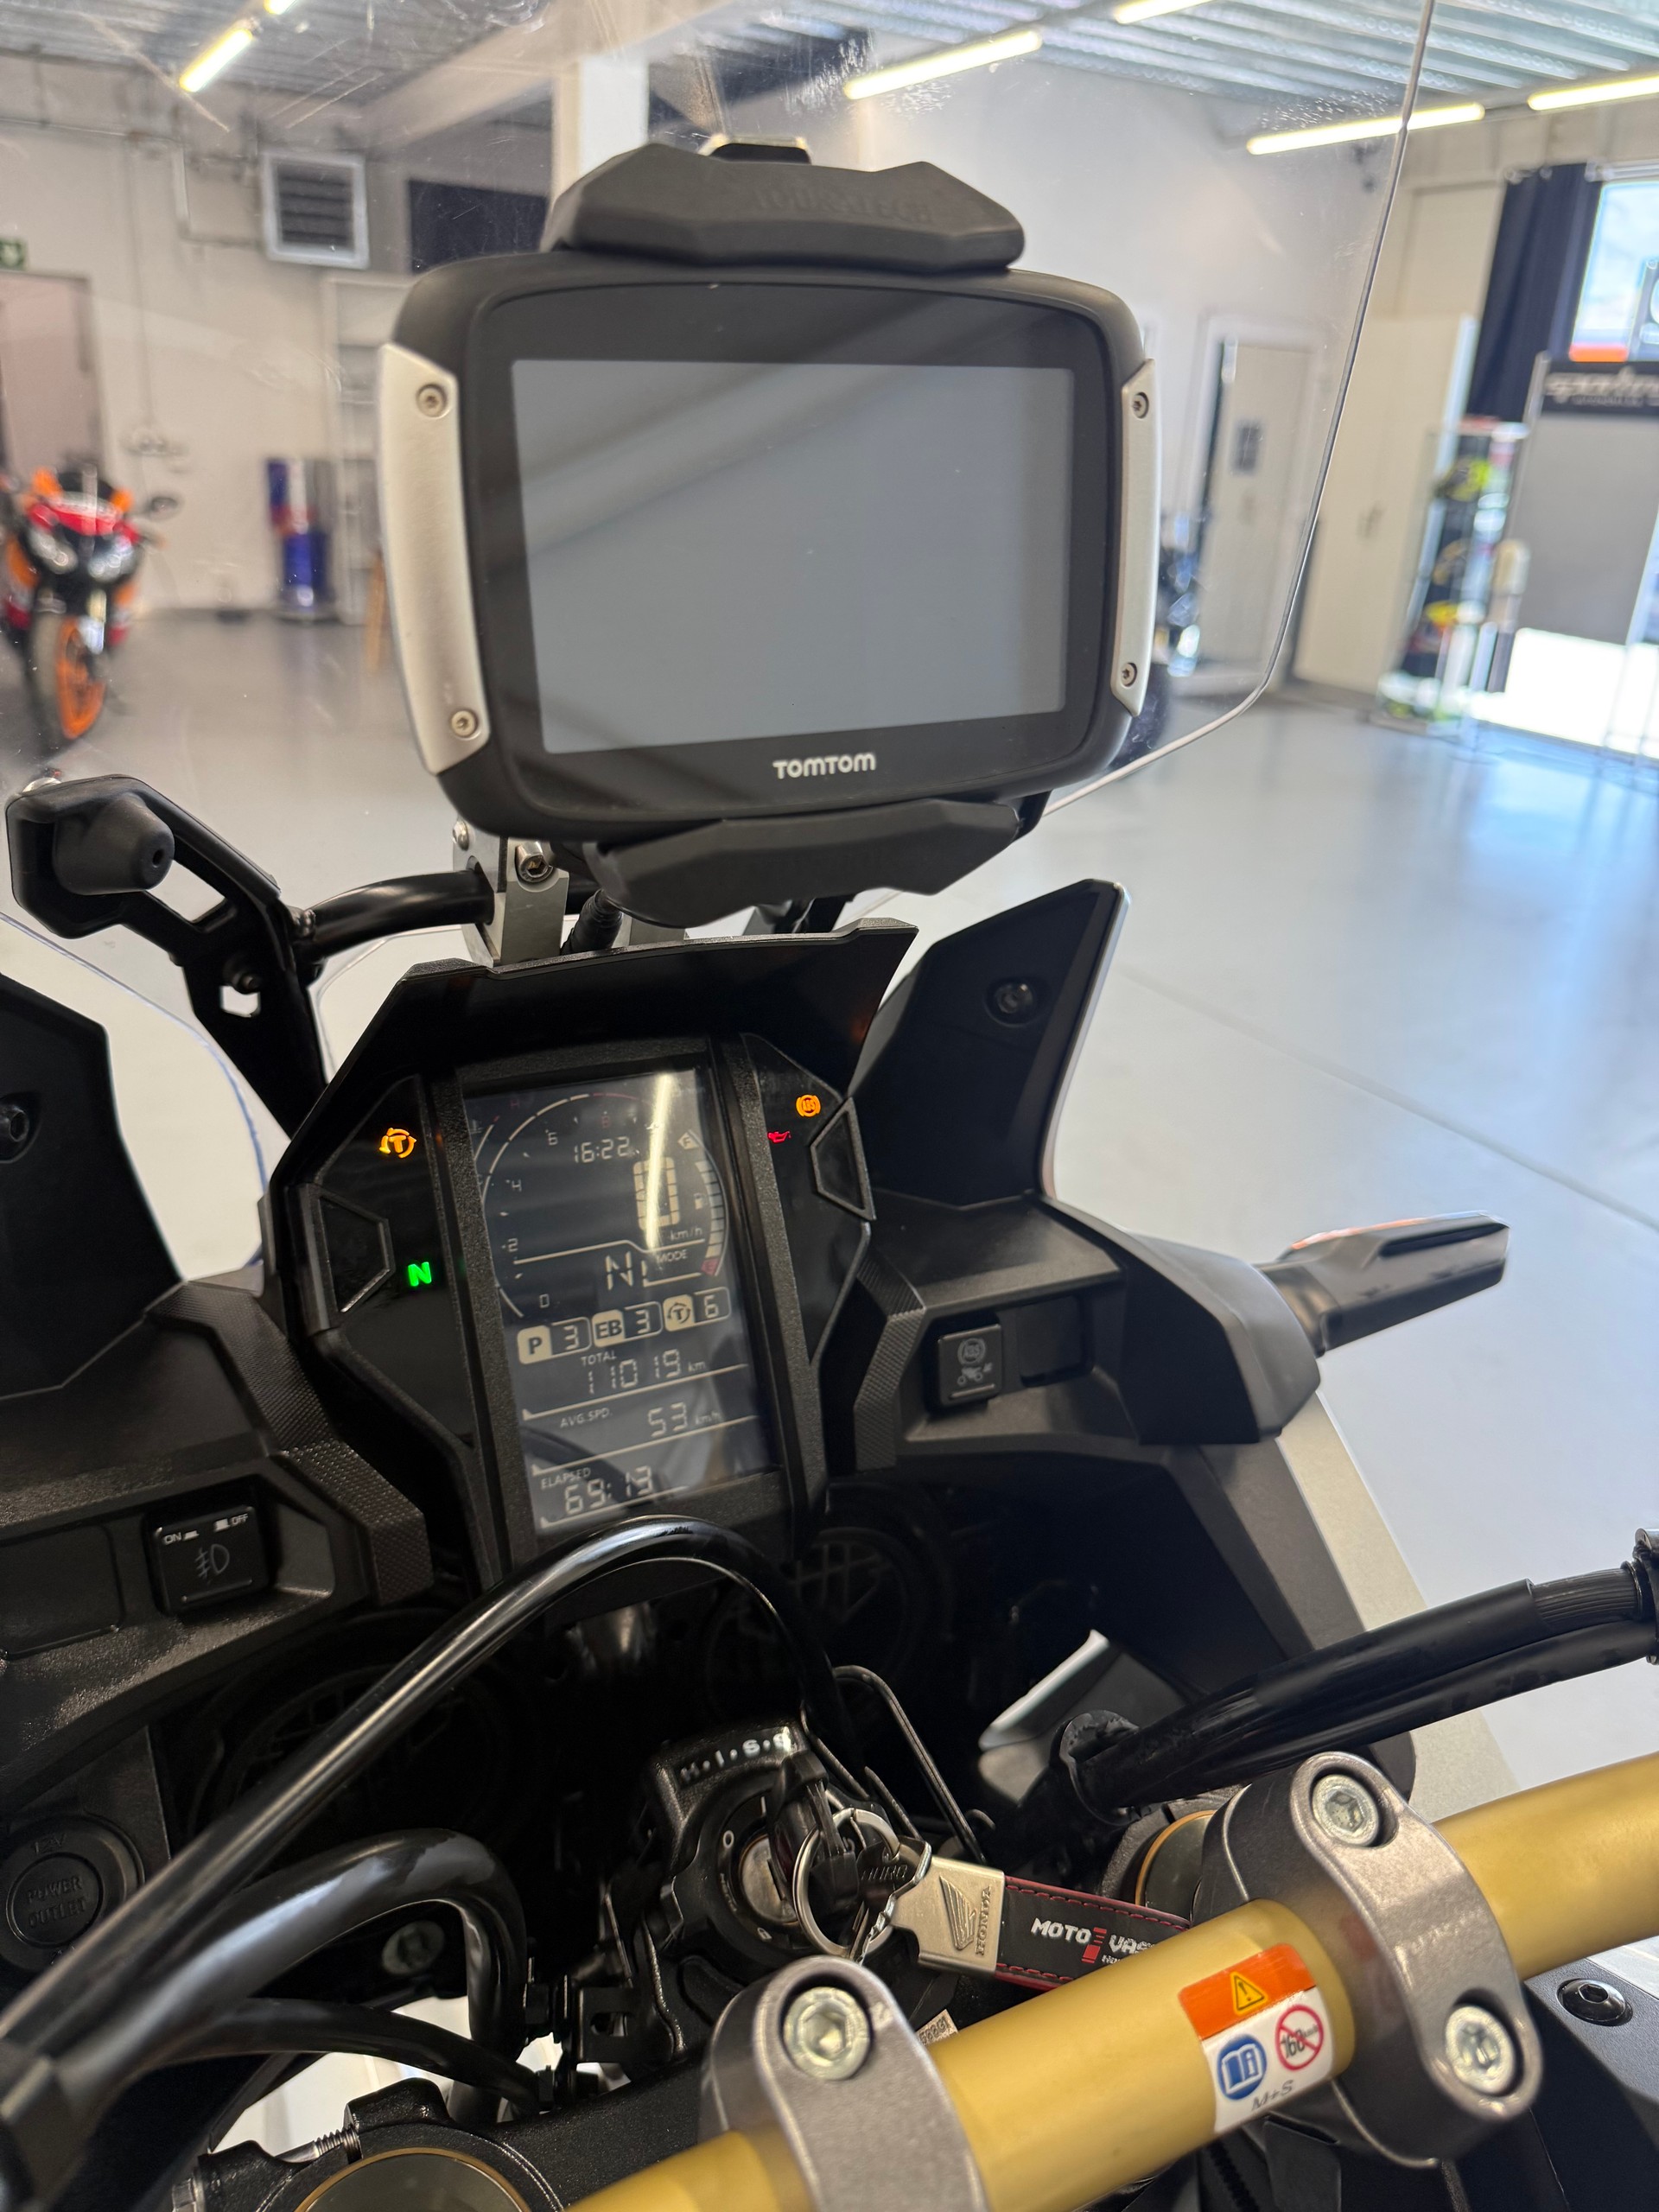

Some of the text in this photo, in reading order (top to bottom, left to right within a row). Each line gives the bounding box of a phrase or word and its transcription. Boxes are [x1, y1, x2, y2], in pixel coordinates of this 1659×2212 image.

[574, 1136, 630, 1163] 16:22
[512, 1179, 522, 1192] 4
[508, 1238, 518, 1253] 2
[670, 1226, 703, 1242] km/h
[656, 1249, 688, 1263] MODE
[408, 1262, 432, 1287] N
[539, 1294, 550, 1309] 0
[703, 1294, 720, 1319] 6
[595, 1308, 651, 1339] EB 3
[528, 1324, 580, 1356] P 3
[581, 1350, 617, 1366] TOTAL
[688, 1360, 706, 1373] km
[648, 1402, 721, 1438] 53 km/h
[541, 1467, 592, 1490] ELAPSED
[564, 1465, 653, 1515] 69:13
[230, 1513, 249, 1526] OFF
[163, 1532, 182, 1545] ON
[28, 1875, 83, 1904] POWER
[28, 1896, 87, 1929] OUTLET
[975, 1885, 992, 1956] HONDA
[1030, 1916, 1092, 1944] MOTO
